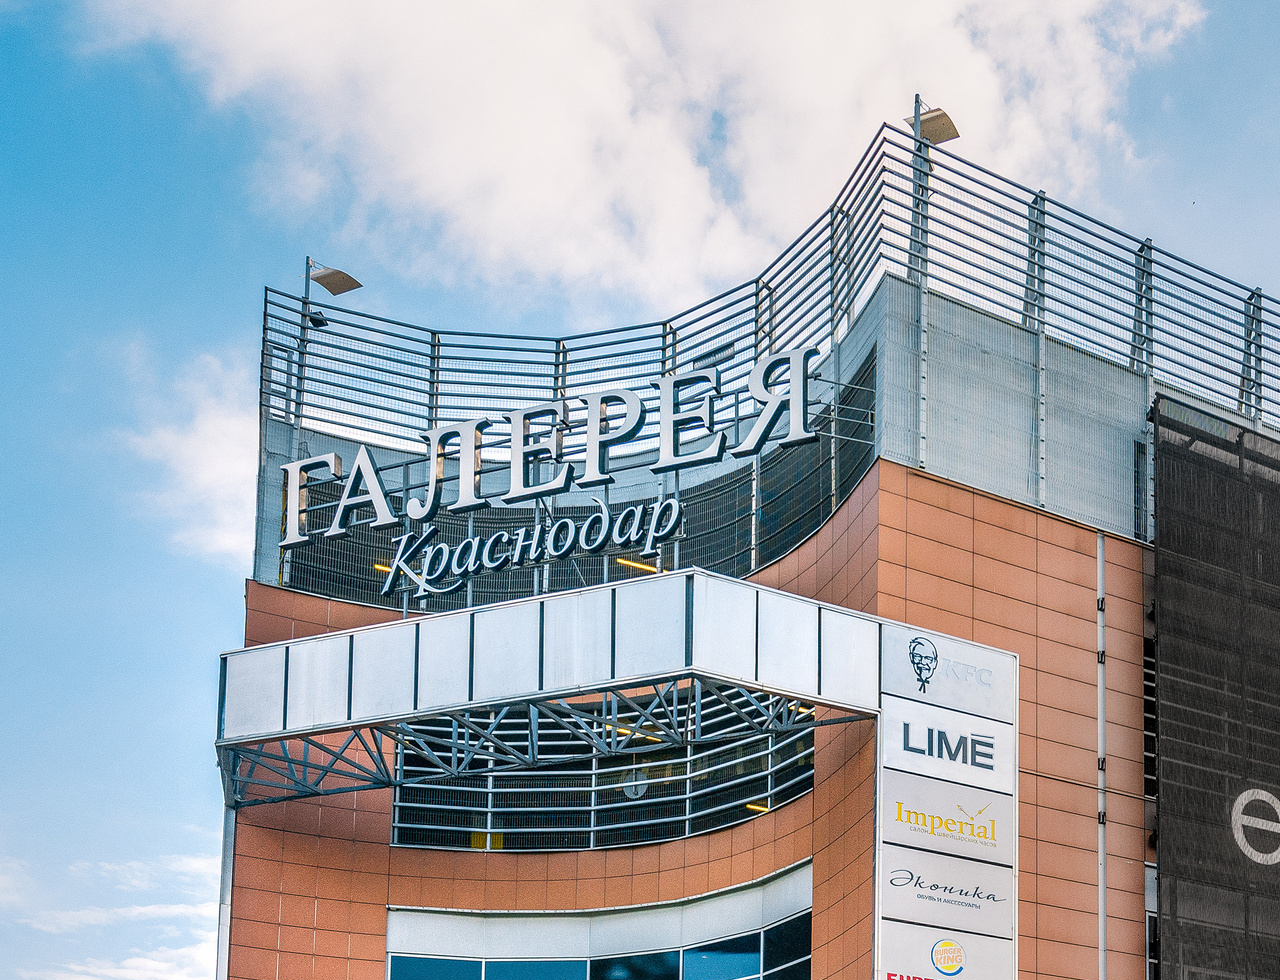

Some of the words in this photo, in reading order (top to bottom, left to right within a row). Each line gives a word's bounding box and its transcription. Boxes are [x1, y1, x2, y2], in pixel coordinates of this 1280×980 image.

[279, 346, 820, 549] ГАЛЕРЕЯ
[381, 497, 684, 599] Краснодар
[895, 801, 997, 841] Imperial
[890, 869, 1007, 903] Эконика
[934, 947, 962, 957] BURGER
[935, 954, 963, 966] KING
